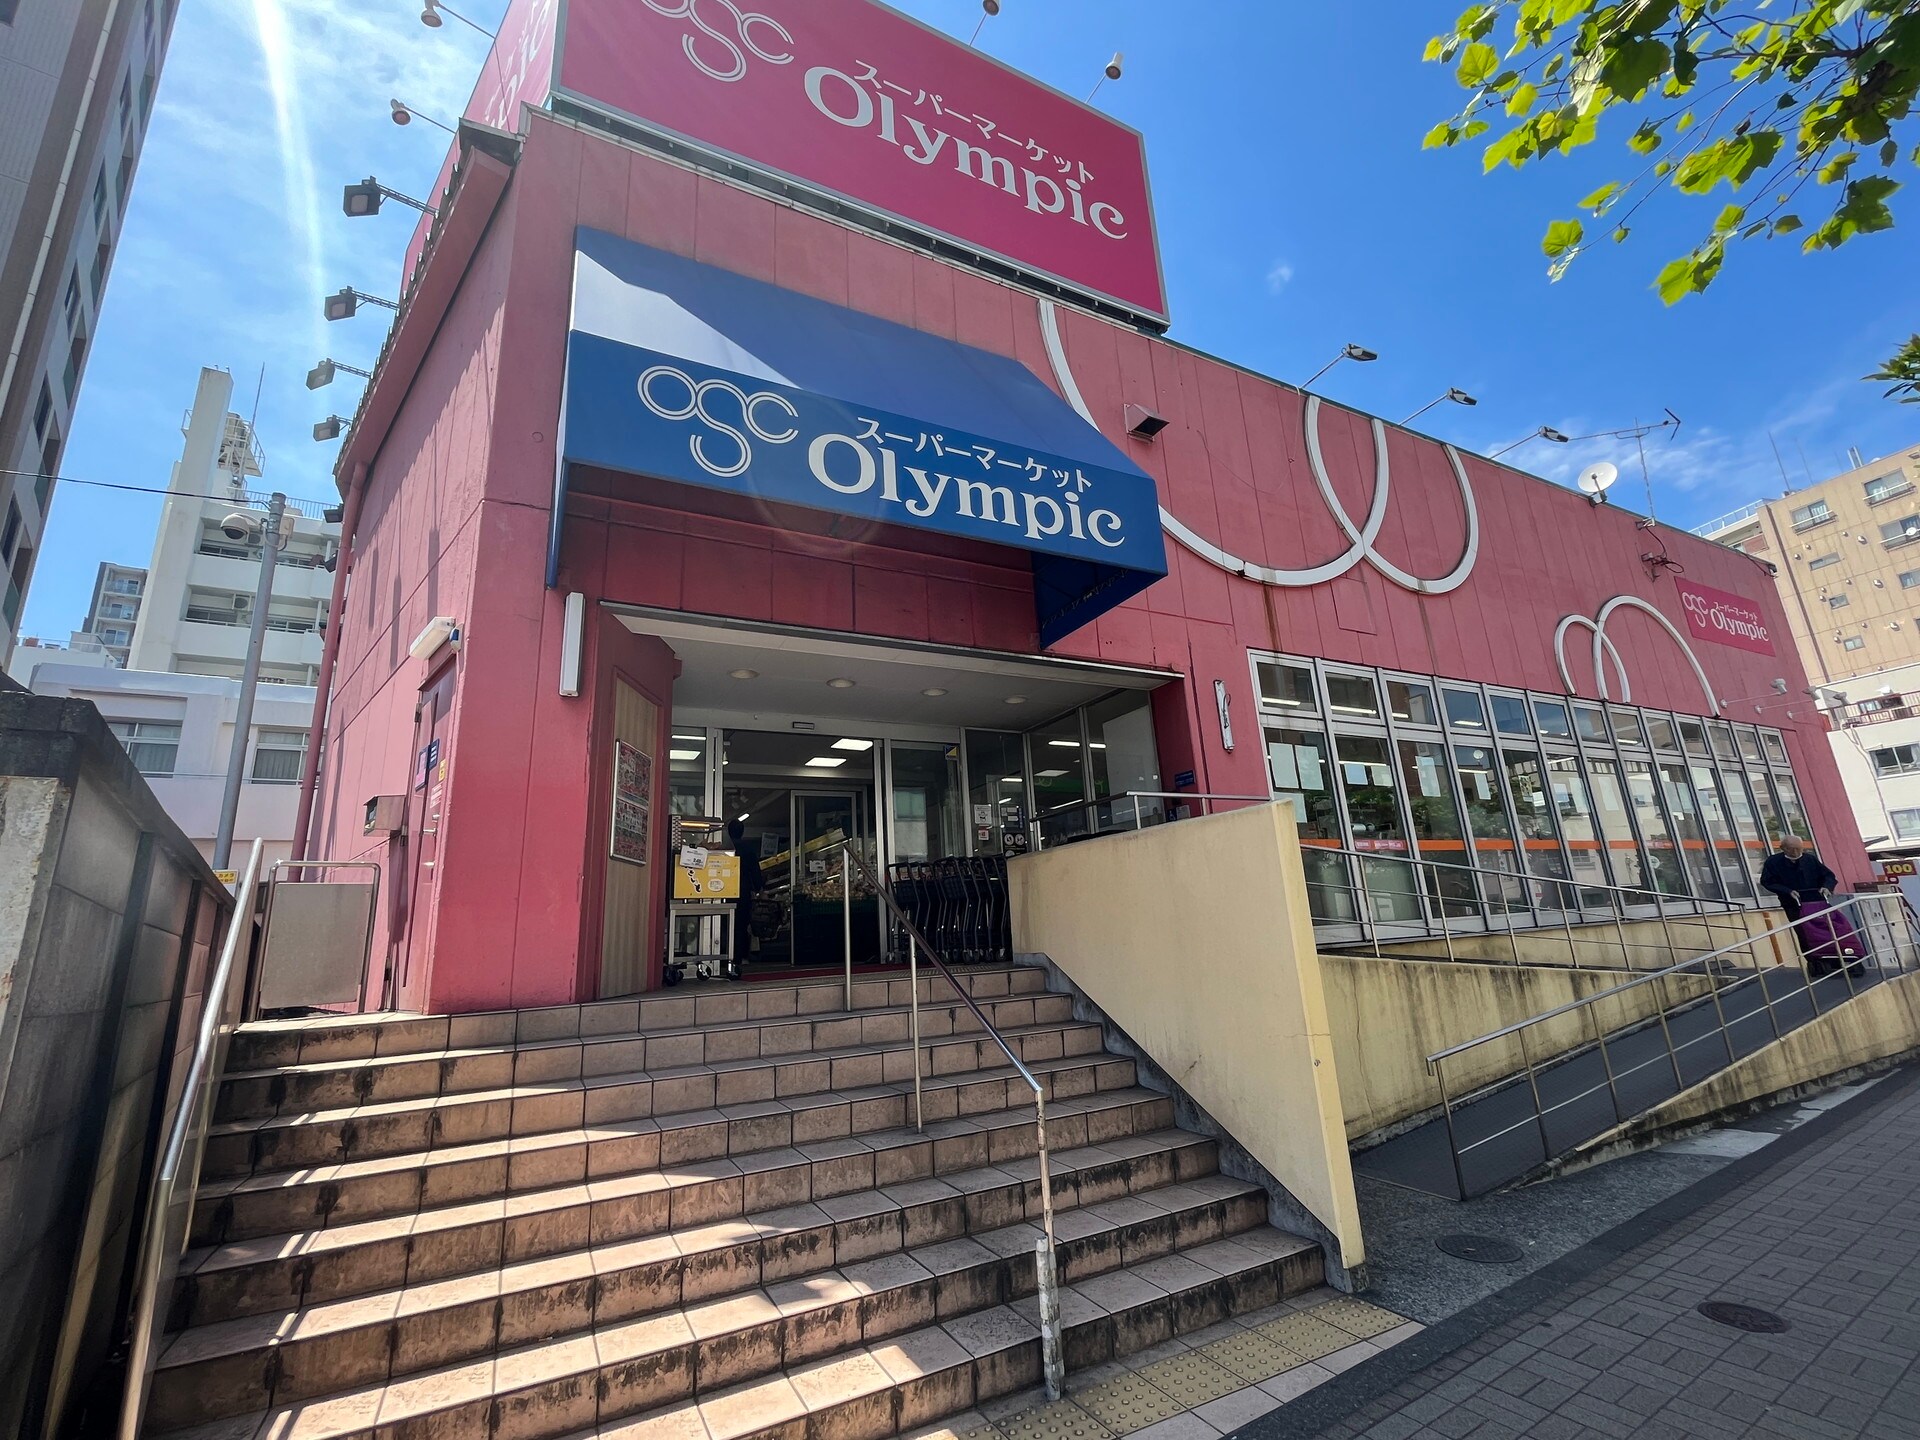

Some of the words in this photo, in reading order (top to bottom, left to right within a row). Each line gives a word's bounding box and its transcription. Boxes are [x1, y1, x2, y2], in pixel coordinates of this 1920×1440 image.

[804, 66, 1128, 240] Olympic
[854, 59, 1095, 183] スーパーマーケット
[808, 433, 1125, 547] Olympic
[856, 416, 1092, 492] スーパーマーケット
[1710, 608, 1769, 642] Olympic
[1884, 863, 1913, 874] 100
